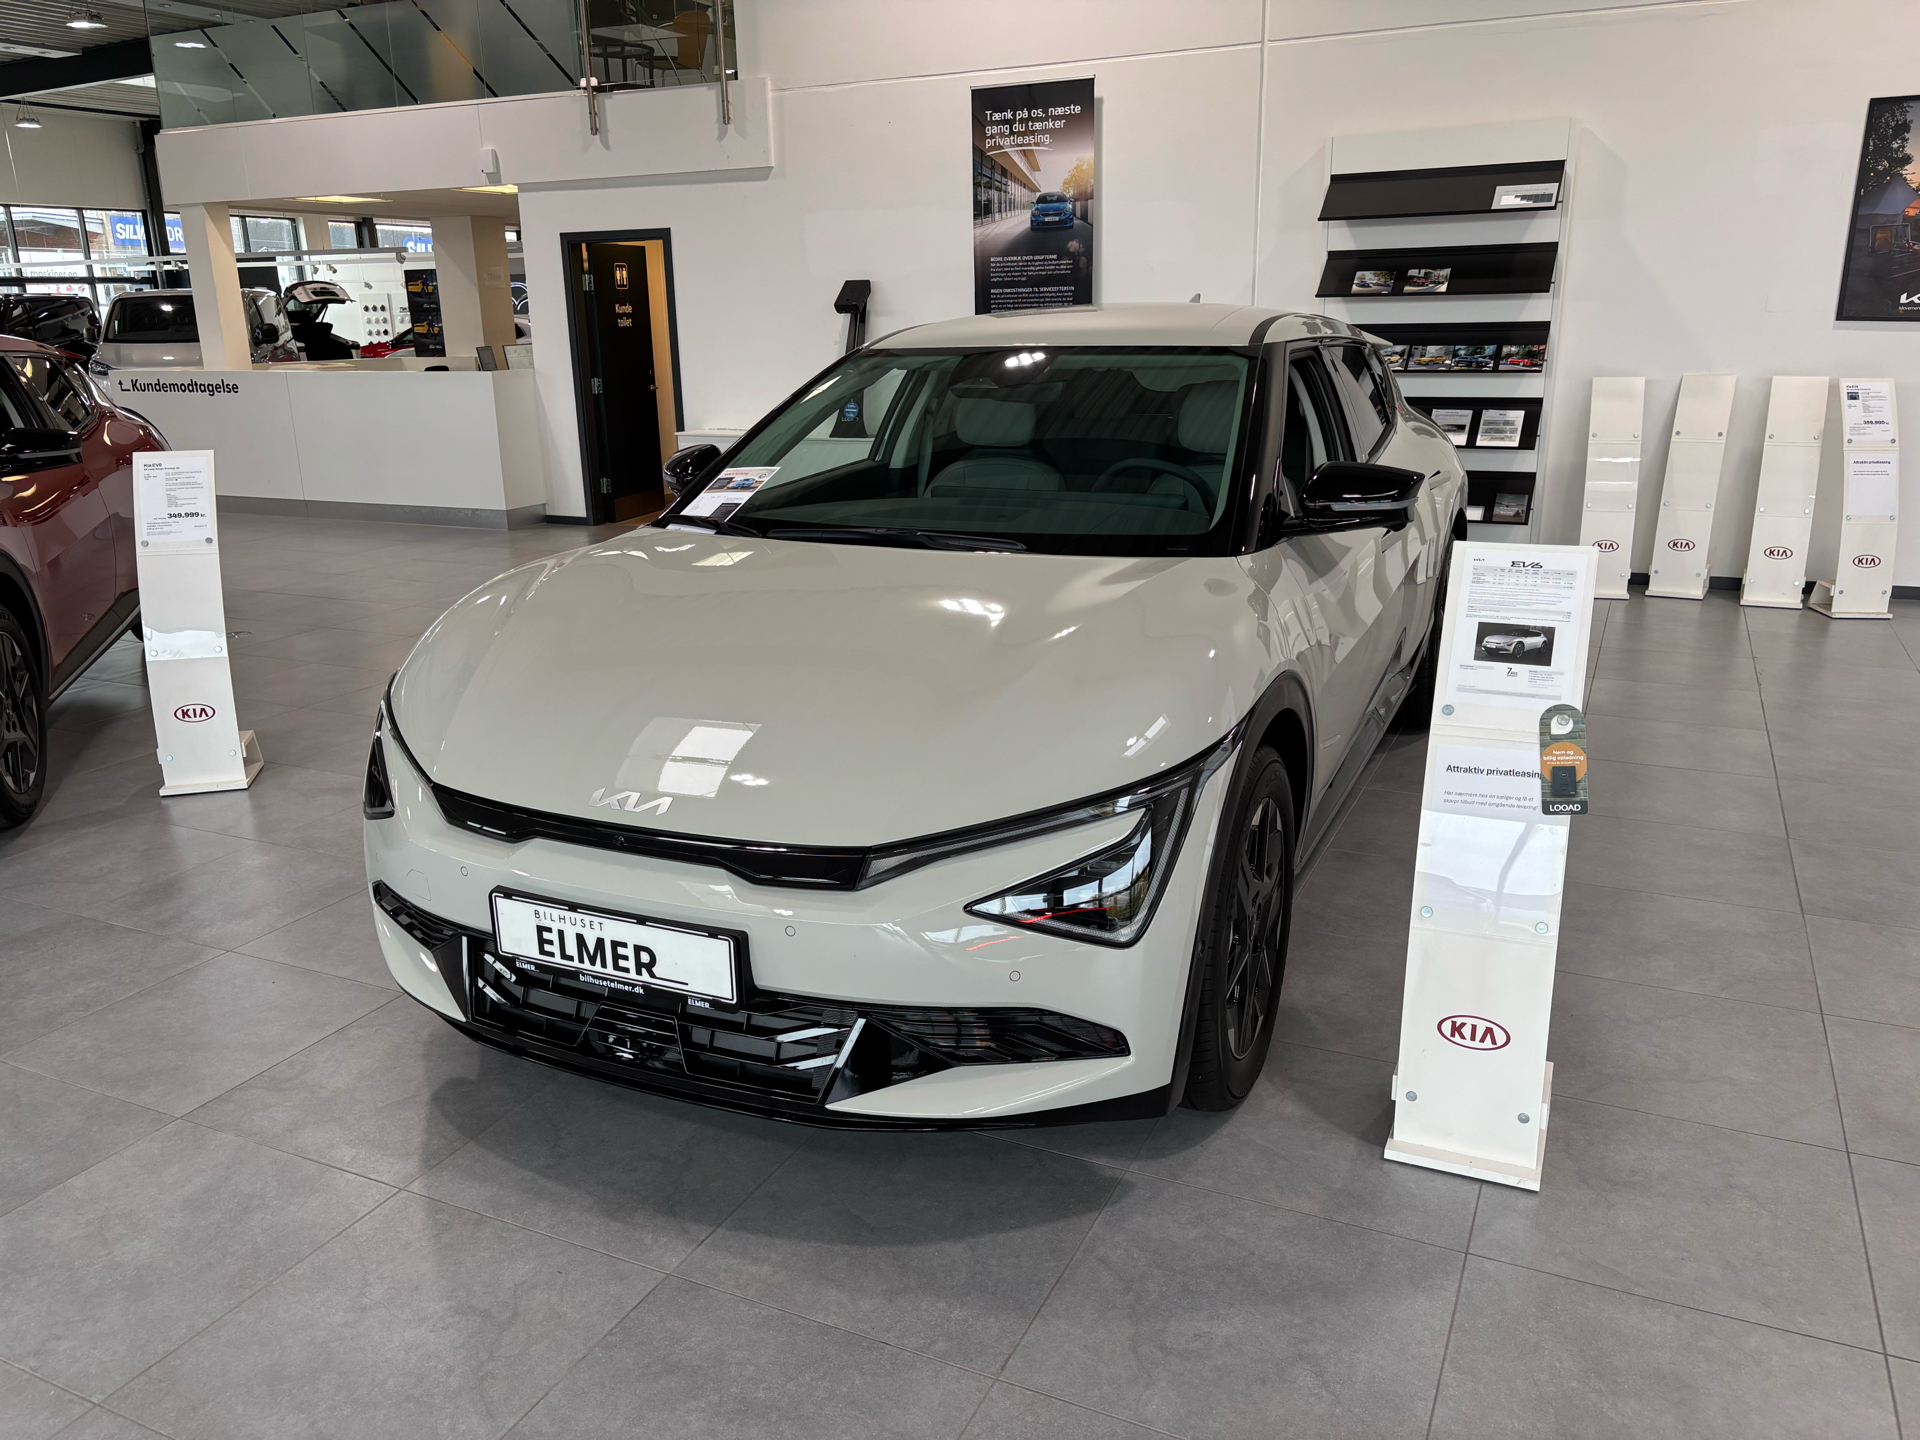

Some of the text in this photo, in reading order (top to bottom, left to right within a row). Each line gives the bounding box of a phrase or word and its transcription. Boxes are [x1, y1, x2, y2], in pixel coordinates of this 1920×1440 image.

[984, 104, 1082, 121] Tænk på os, næste
[985, 118, 1066, 136] gang du tænker
[985, 132, 1053, 149] privatleasing.
[614, 302, 632, 314] Kunde
[618, 316, 632, 327] toilet
[130, 378, 239, 396] Kundemodtagelse
[1769, 549, 1788, 557] KIA
[181, 708, 209, 719] KIA
[1446, 764, 1485, 774] Attraktiv
[534, 910, 604, 932] BILHUSET
[536, 924, 660, 979] ELMER
[516, 961, 536, 970] ELMER
[579, 974, 644, 995] bilhusetelmer.dk
[688, 998, 710, 1008] ELMER
[1450, 1020, 1497, 1046] KIA
